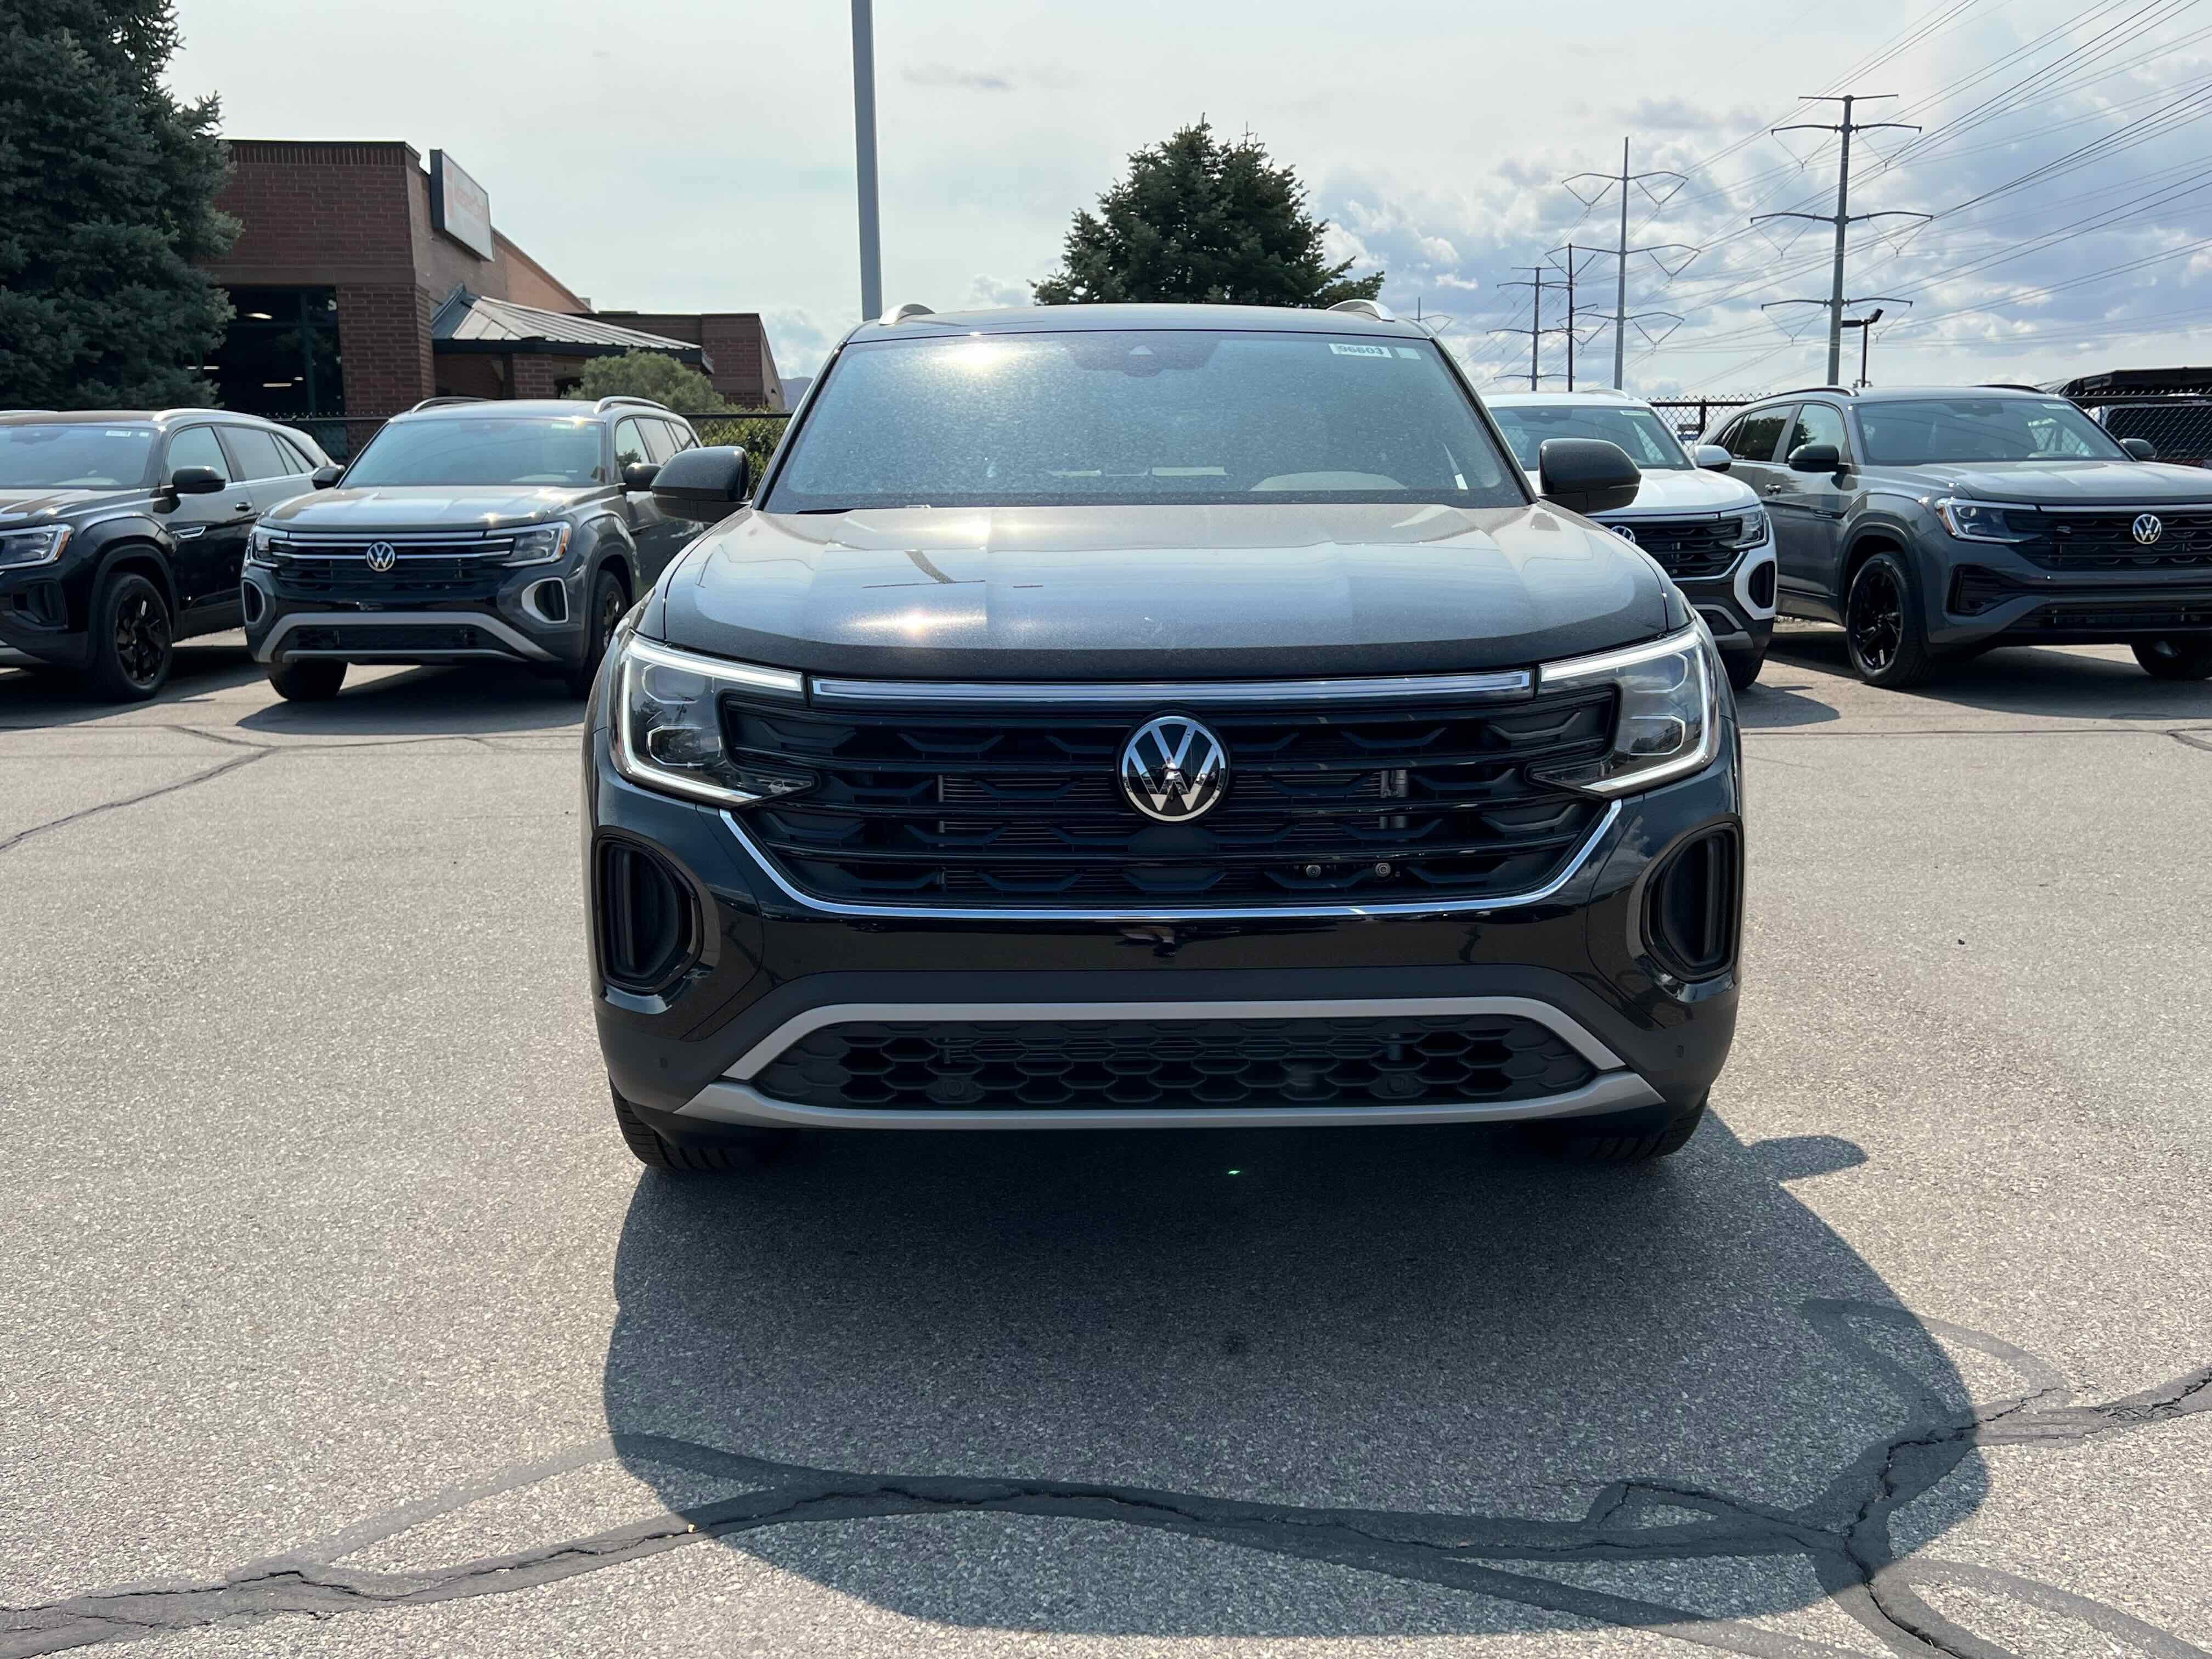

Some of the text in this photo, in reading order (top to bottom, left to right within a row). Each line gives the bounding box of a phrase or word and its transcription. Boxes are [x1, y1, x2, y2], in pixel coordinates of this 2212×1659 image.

[2135, 515, 2160, 542] VW
[368, 543, 394, 570] VW
[1125, 719, 1222, 816] VW
